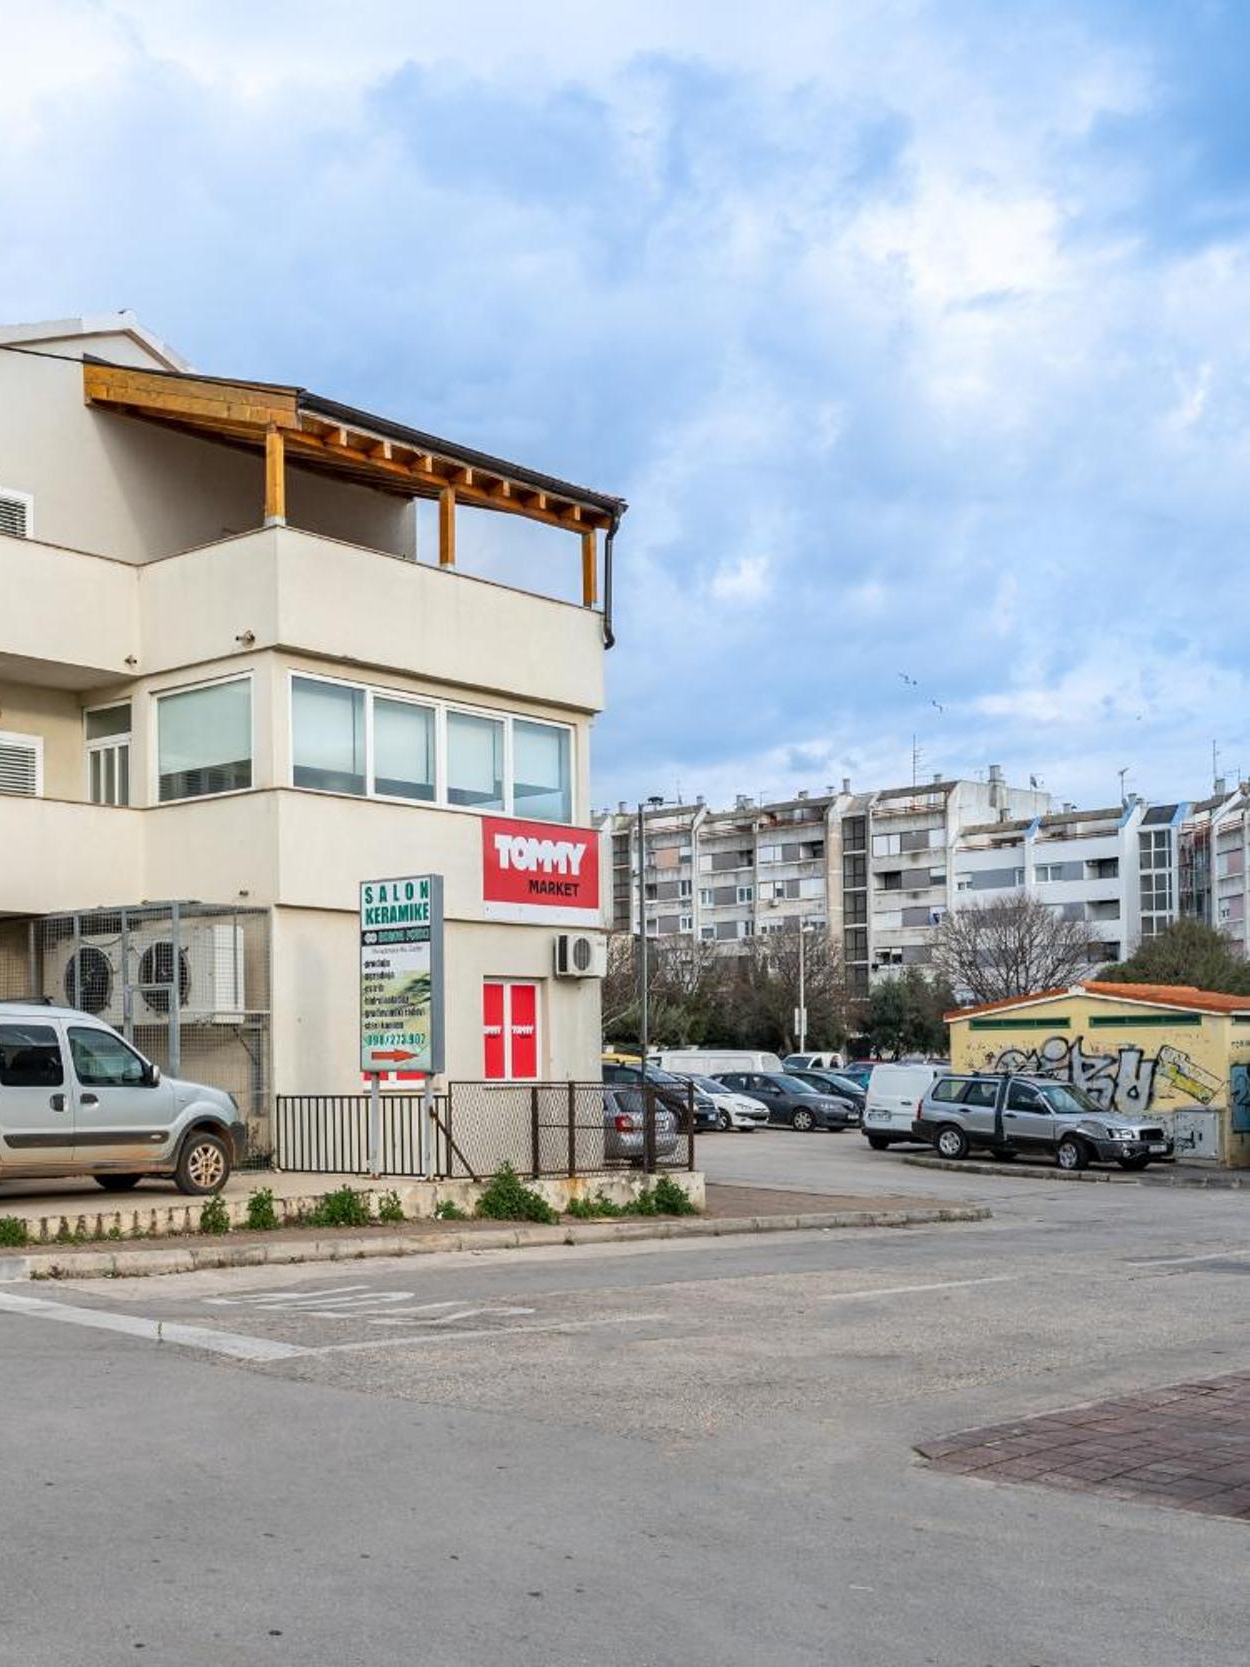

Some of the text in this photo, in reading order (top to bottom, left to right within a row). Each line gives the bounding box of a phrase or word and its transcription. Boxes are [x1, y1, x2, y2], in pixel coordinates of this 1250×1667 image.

[494, 834, 588, 876] TOMMY
[364, 880, 429, 904] SALON
[528, 880, 580, 897] MARKET
[365, 902, 429, 925] KERAMIKE
